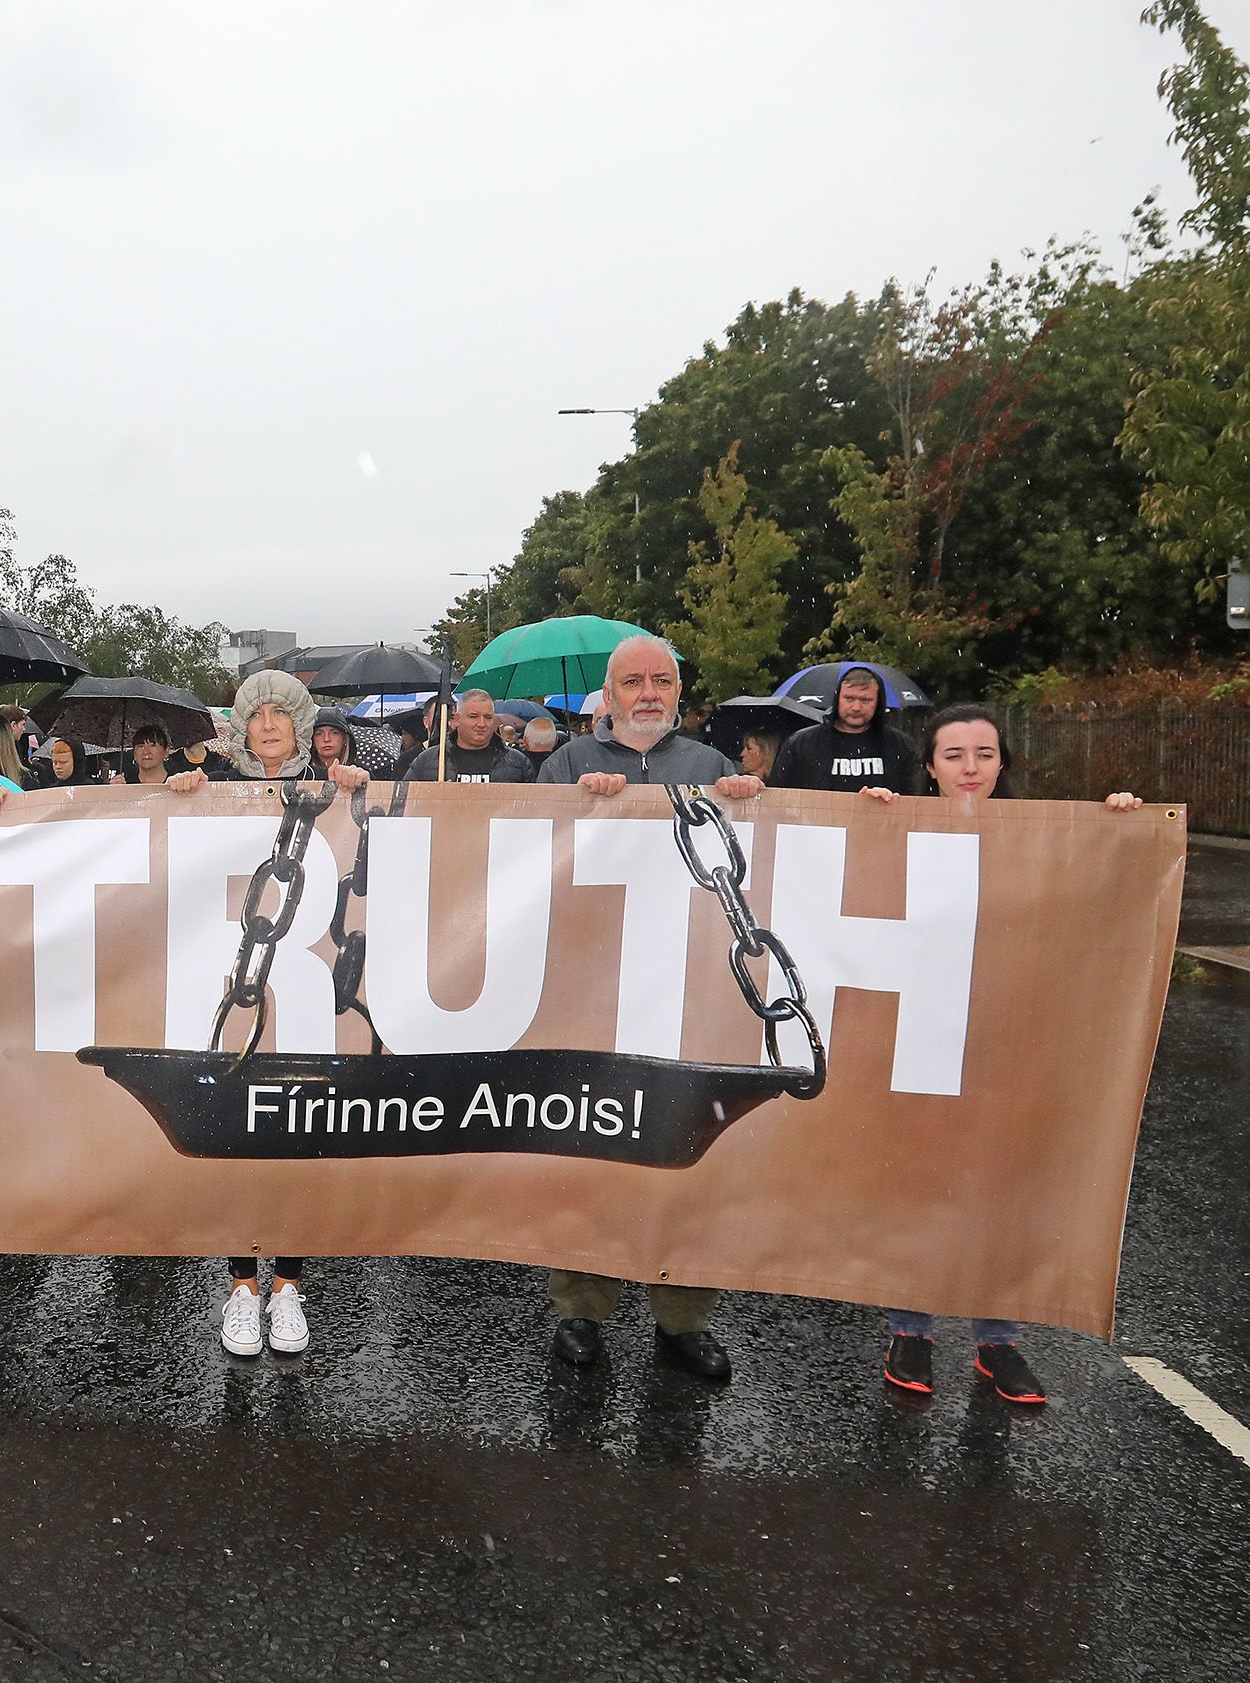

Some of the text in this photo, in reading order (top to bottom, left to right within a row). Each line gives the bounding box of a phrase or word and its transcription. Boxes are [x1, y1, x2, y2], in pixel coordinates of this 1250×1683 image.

[831, 757, 884, 776] TRUTH
[246, 1082, 645, 1140] Fírinne Anois!
